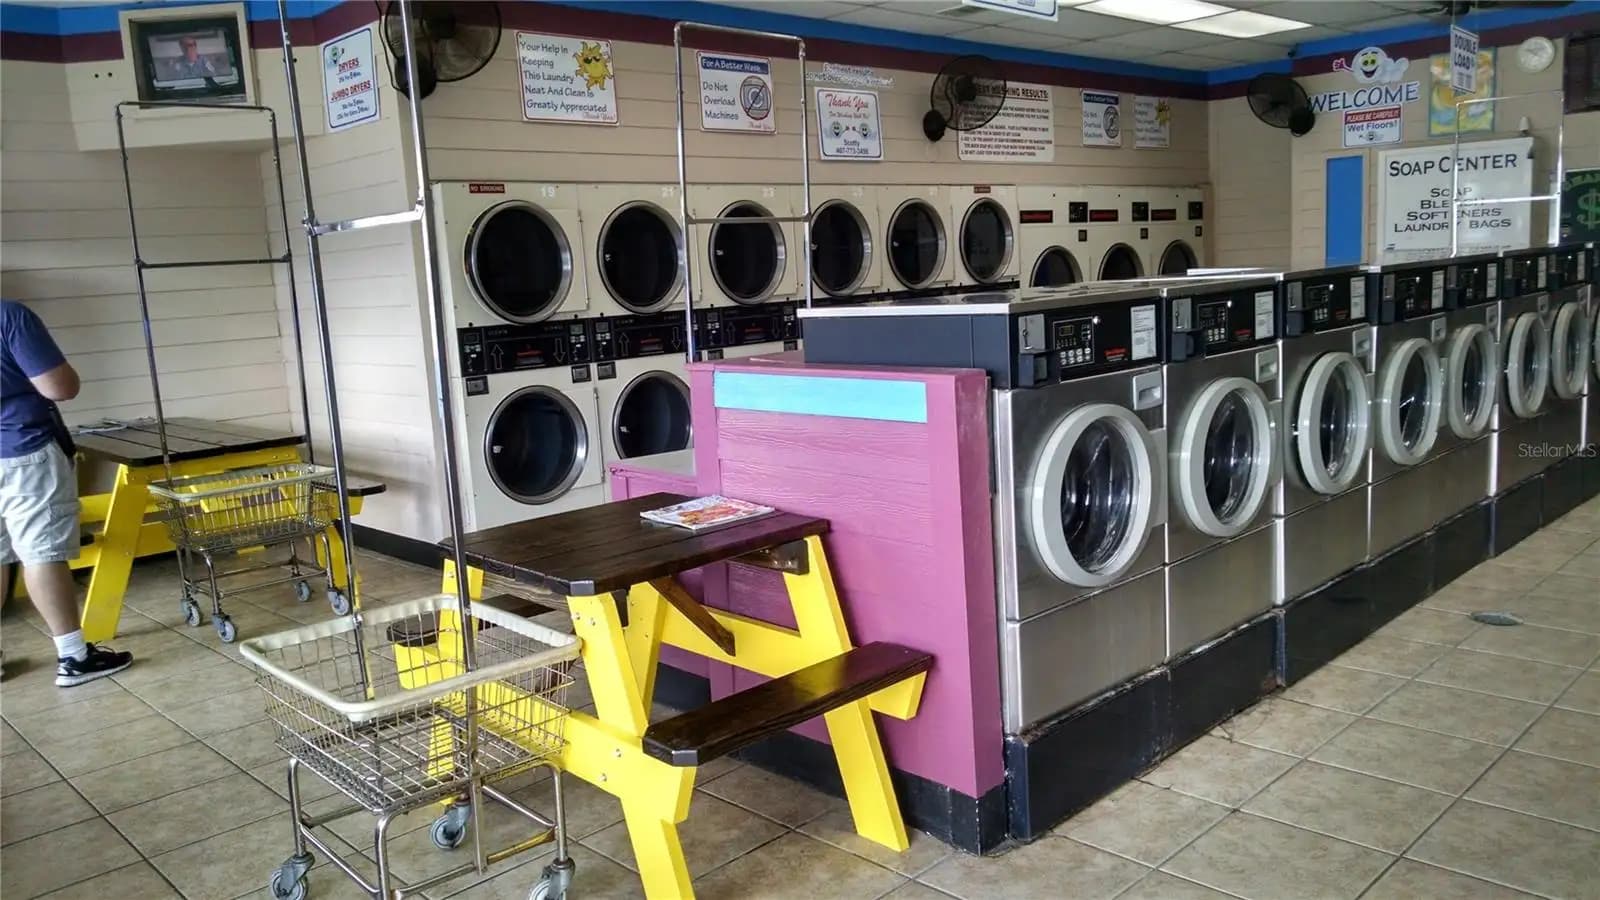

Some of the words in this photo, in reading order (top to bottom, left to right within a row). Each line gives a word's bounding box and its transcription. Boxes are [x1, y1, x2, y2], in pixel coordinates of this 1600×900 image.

[520, 41, 540, 51] Your
[541, 43, 560, 55] Help
[1455, 33, 1476, 55] DOUBLE
[338, 57, 360, 72] DRYERS
[522, 56, 554, 69] Keeping
[703, 58, 714, 66] For
[721, 60, 743, 69] Better
[523, 70, 540, 80] This
[542, 72, 575, 84] Laundry
[350, 80, 371, 94] DRYERS
[525, 85, 546, 95] Neat
[547, 86, 563, 96] And
[564, 87, 586, 97] Clean
[587, 89, 594, 98] Is
[703, 82, 713, 90] Do
[714, 82, 728, 91] Not
[1021, 87, 1048, 98] RESULTS:
[704, 96, 735, 106] Overload
[825, 93, 852, 108] Thank
[1308, 83, 1418, 112] WELCOME
[527, 99, 558, 111] Greatly
[560, 101, 607, 113] Appreciated
[705, 110, 739, 120] Machines
[1347, 124, 1364, 132] Wet
[1366, 120, 1397, 130] Floors!
[1389, 160, 1435, 177] SOAP
[1438, 153, 1517, 172] CENTER
[1421, 198, 1485, 209] BLECH
[1469, 219, 1512, 229] BAGS
